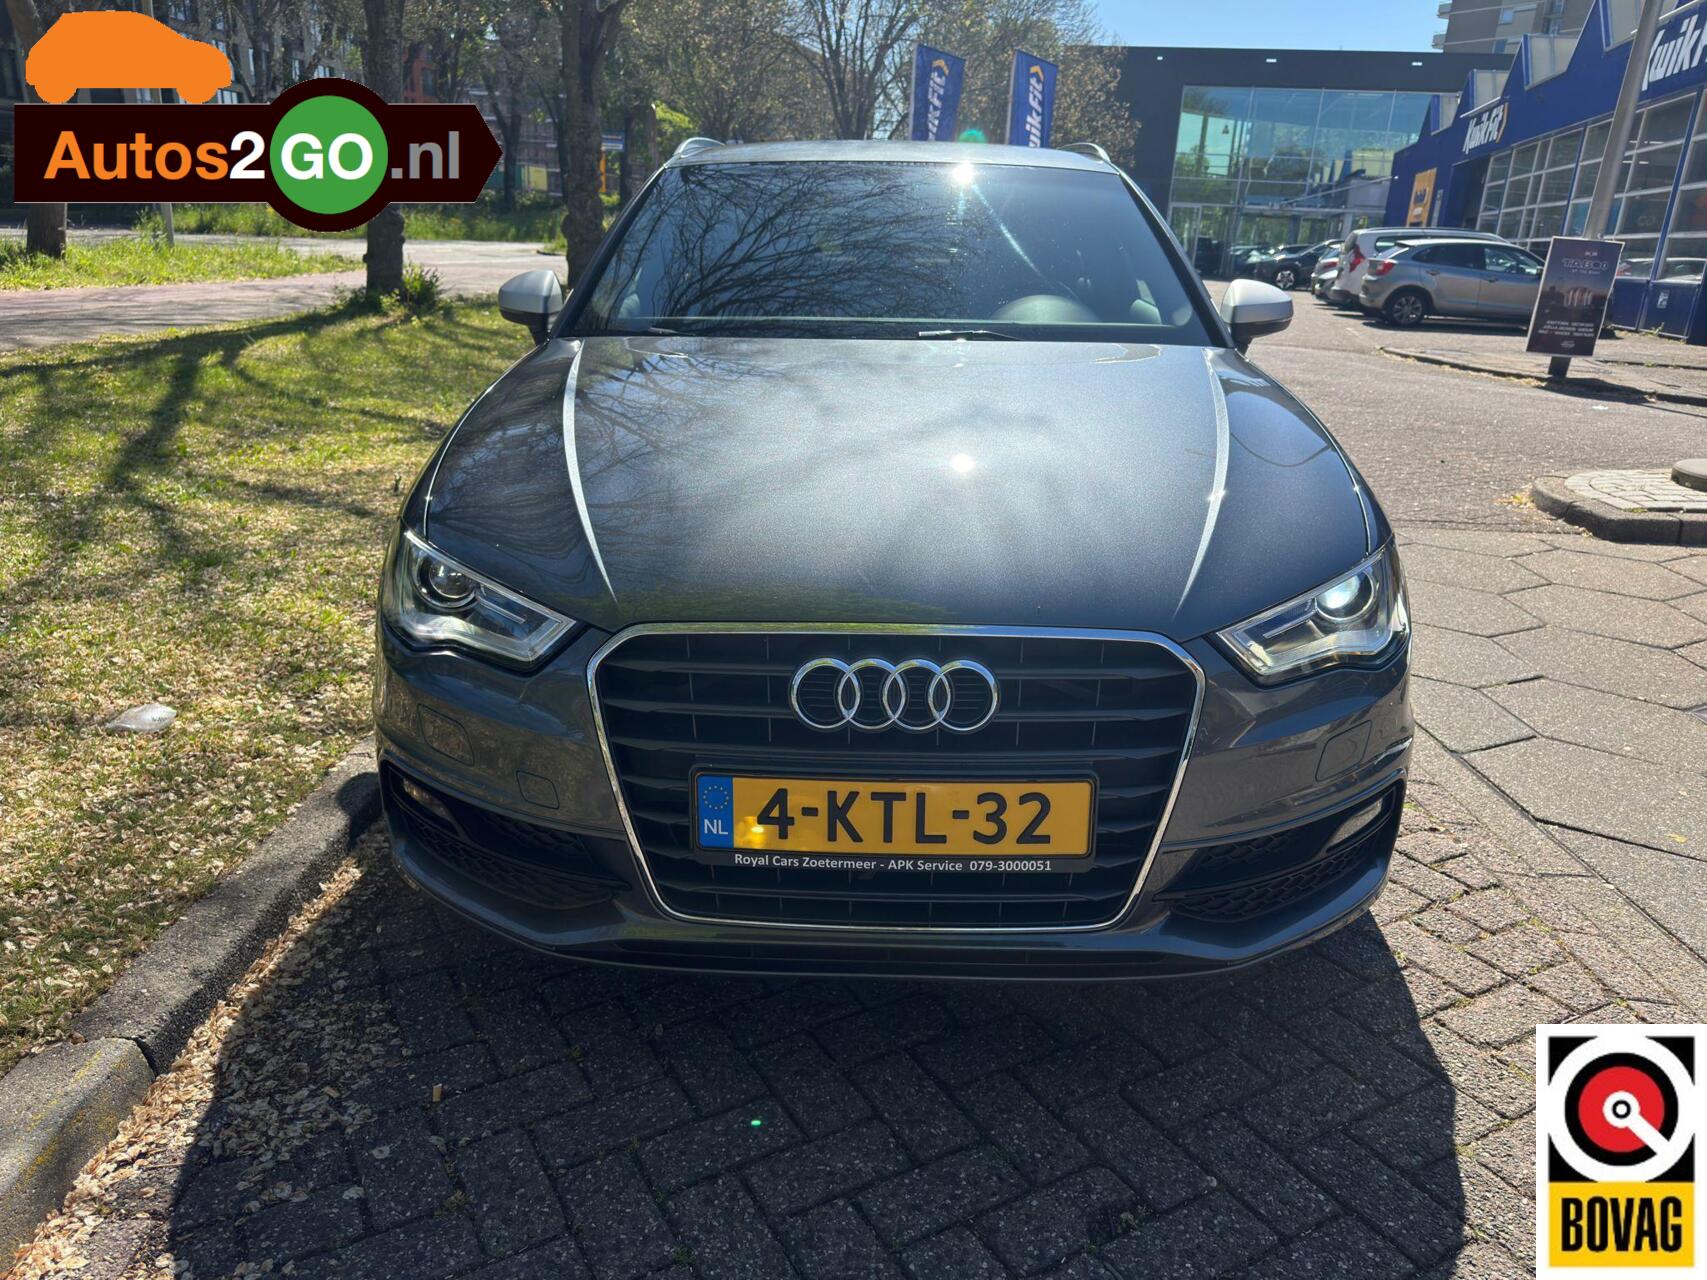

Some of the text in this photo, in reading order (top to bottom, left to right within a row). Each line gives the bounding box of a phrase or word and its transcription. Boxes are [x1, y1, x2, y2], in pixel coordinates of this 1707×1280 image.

[757, 787, 1051, 845] 4-KTL-32
[703, 819, 729, 835] NL
[734, 853, 769, 867] Royal
[772, 855, 800, 867] Cars
[802, 857, 877, 869] Zoetermeer
[888, 860, 914, 871] APK
[917, 860, 963, 871] Service
[969, 860, 1052, 872] 079-3000051
